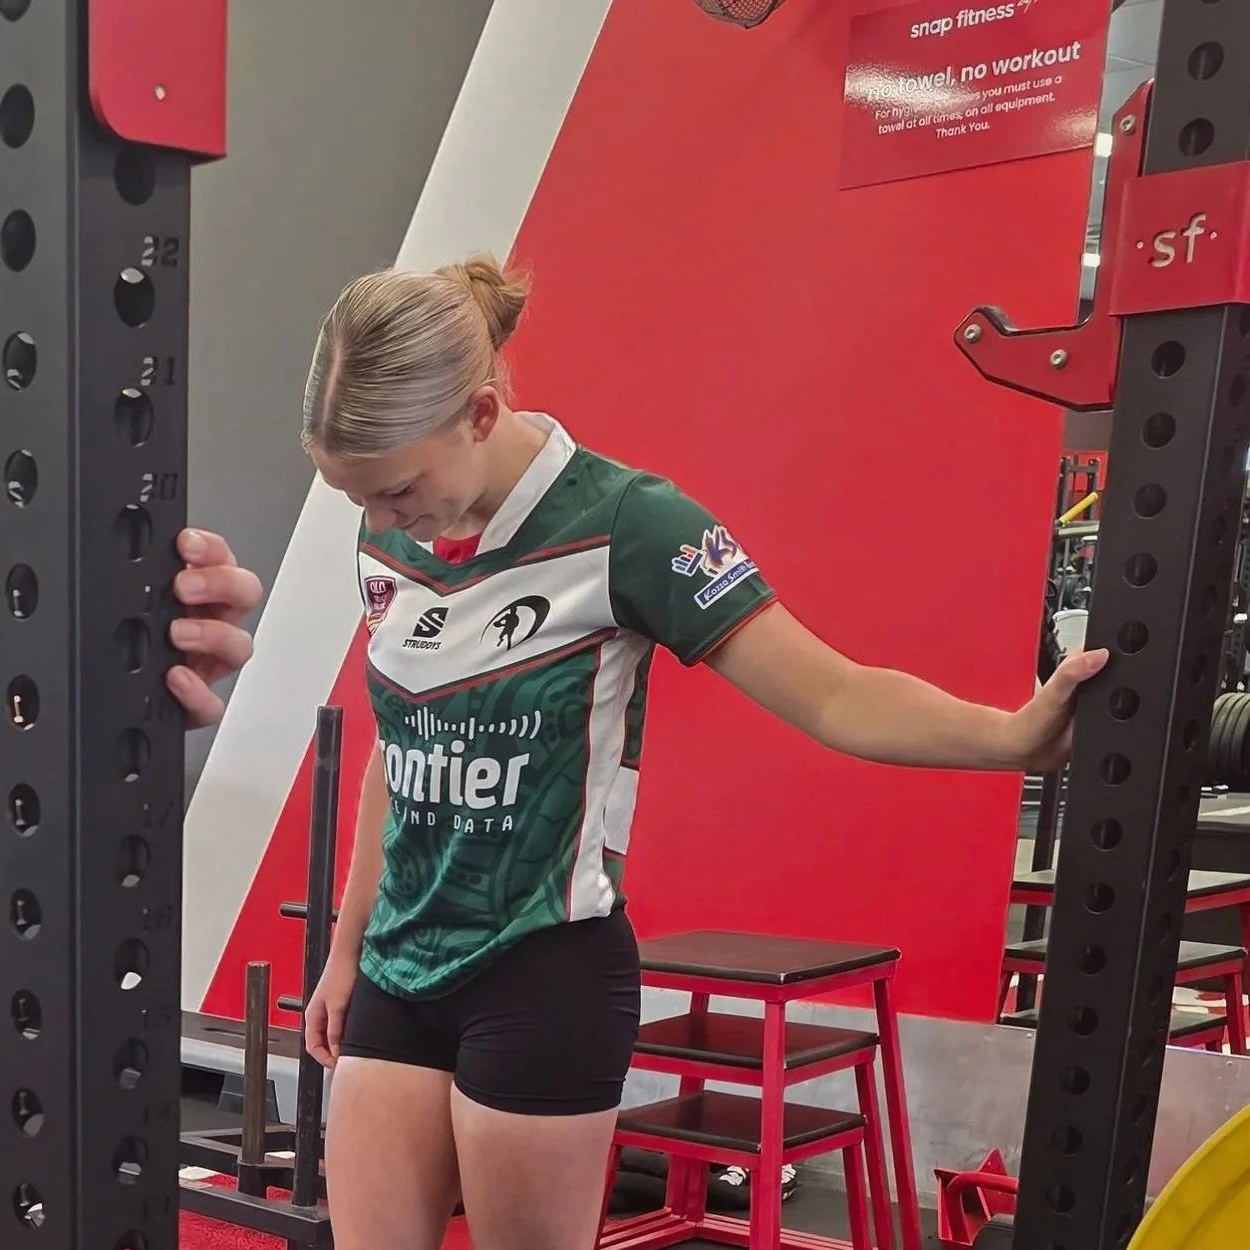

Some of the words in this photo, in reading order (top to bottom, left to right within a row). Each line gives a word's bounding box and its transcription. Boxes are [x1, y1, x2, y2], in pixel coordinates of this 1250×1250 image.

[911, 16, 953, 38] snap
[956, 2, 1015, 27] fitness
[897, 66, 956, 94] towel,
[961, 64, 987, 82] no
[992, 41, 1081, 76] workout
[875, 109, 891, 120] For
[982, 87, 1002, 101] you
[1003, 81, 1031, 94] must
[1032, 77, 1053, 89] use
[1054, 75, 1063, 84] a
[878, 121, 905, 134] towel
[906, 119, 917, 128] at
[965, 107, 979, 118] on
[980, 101, 994, 114] all
[995, 91, 1056, 115] equipment.
[935, 124, 967, 139] Thank
[968, 121, 990, 133] You.
[141, 235, 180, 267] 22
[141, 356, 176, 387] 21
[402, 639, 442, 651] STRUDDYS
[453, 814, 513, 834] DATA
